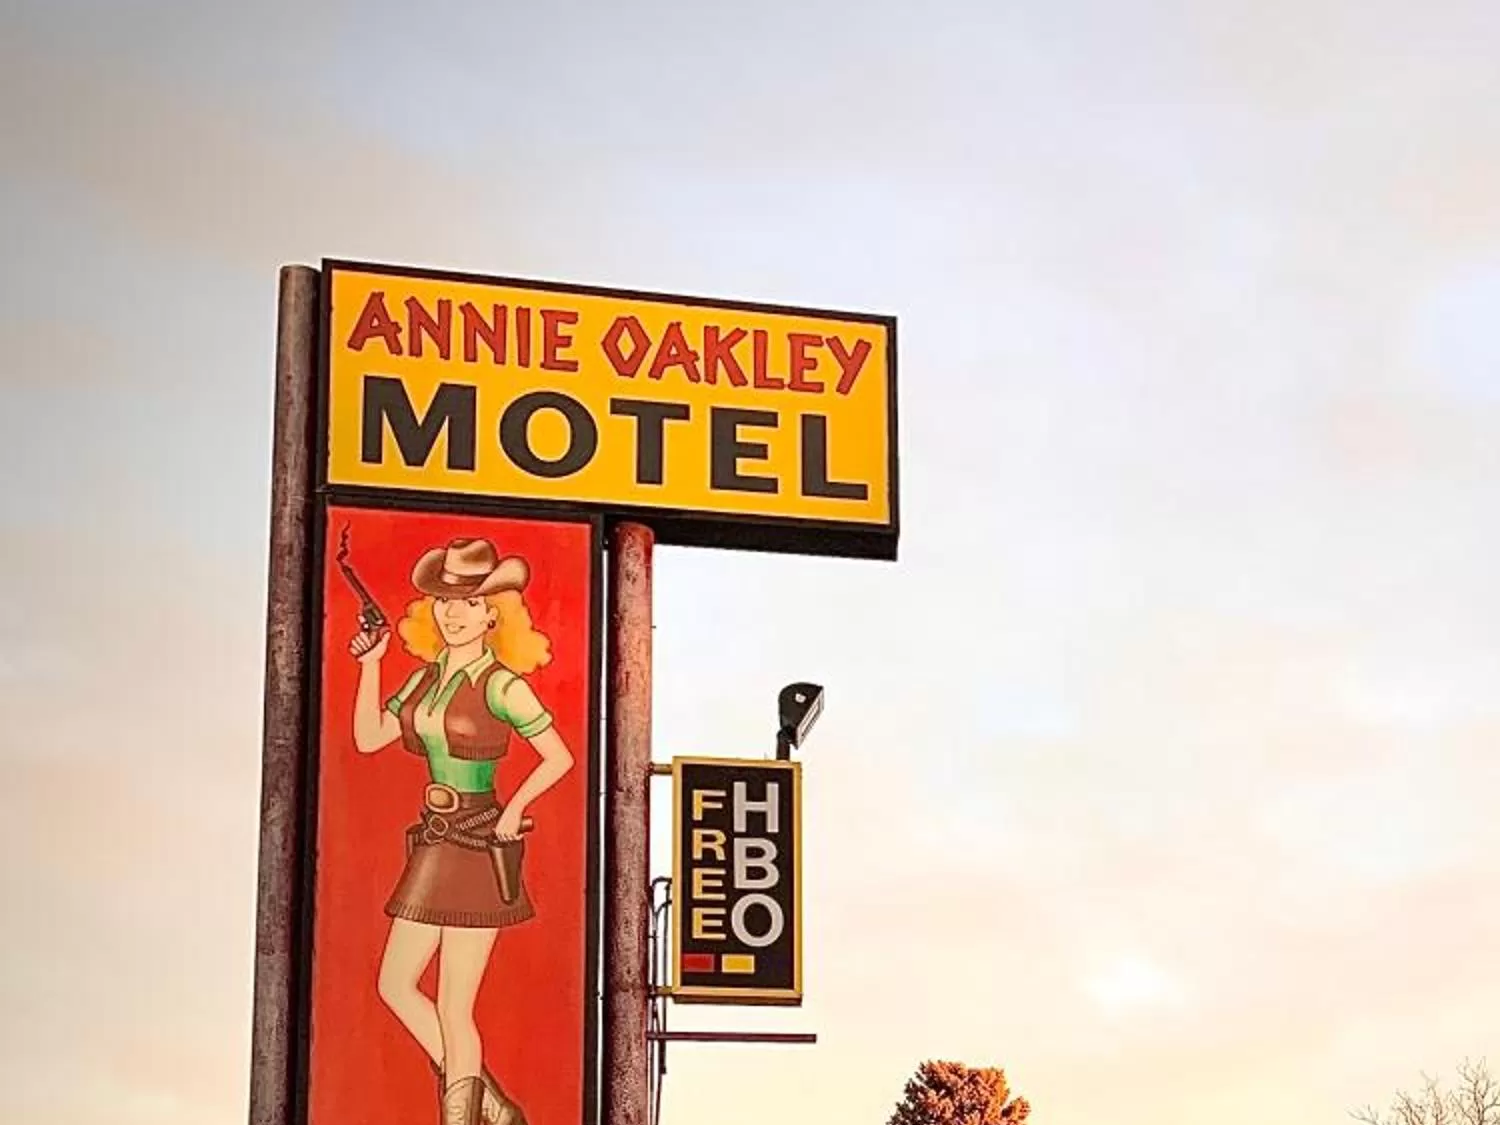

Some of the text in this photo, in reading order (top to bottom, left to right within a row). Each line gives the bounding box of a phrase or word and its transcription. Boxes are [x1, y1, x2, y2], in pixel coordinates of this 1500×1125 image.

[347, 292, 872, 396] ANNIE OAKLEY
[361, 375, 869, 501] MOTEL
[691, 789, 727, 940] FREE
[731, 781, 785, 947] HBO
